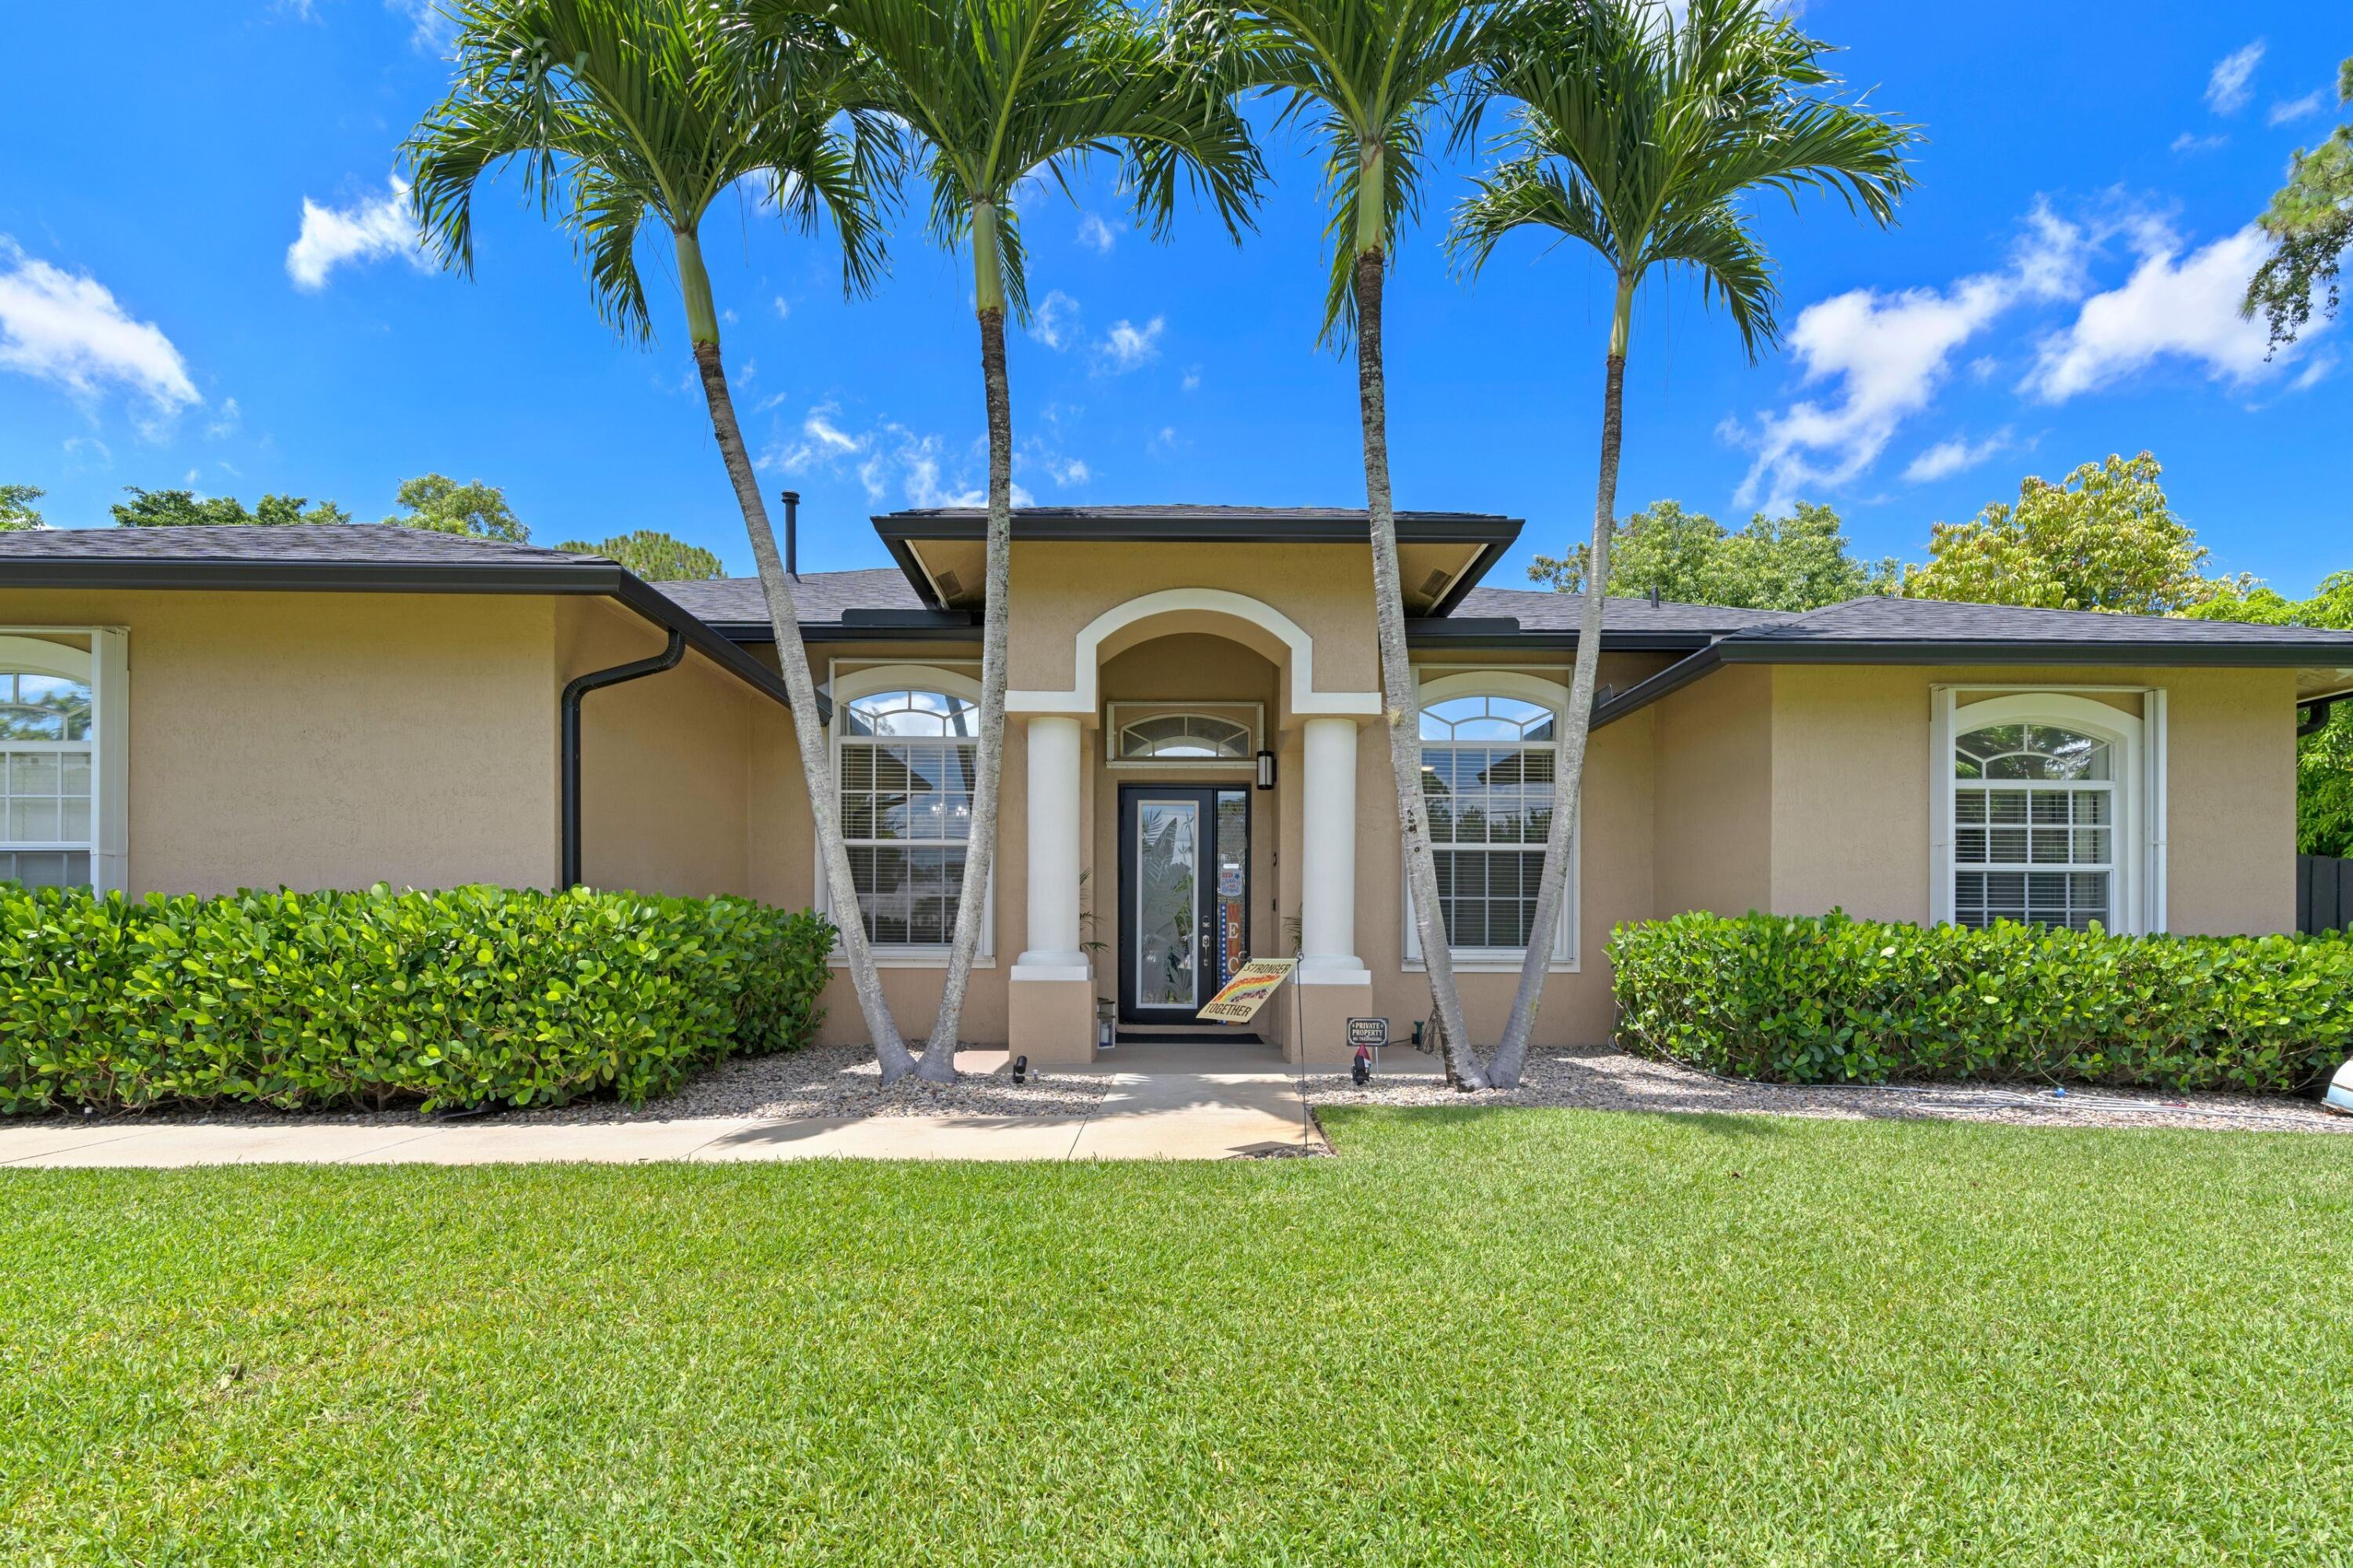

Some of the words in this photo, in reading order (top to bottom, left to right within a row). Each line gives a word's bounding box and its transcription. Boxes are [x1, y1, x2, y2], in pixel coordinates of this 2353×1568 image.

[1227, 904, 1239, 973] WELC
[1243, 963, 1292, 974] STRONGER
[1204, 1003, 1252, 1017] TOGETHER
